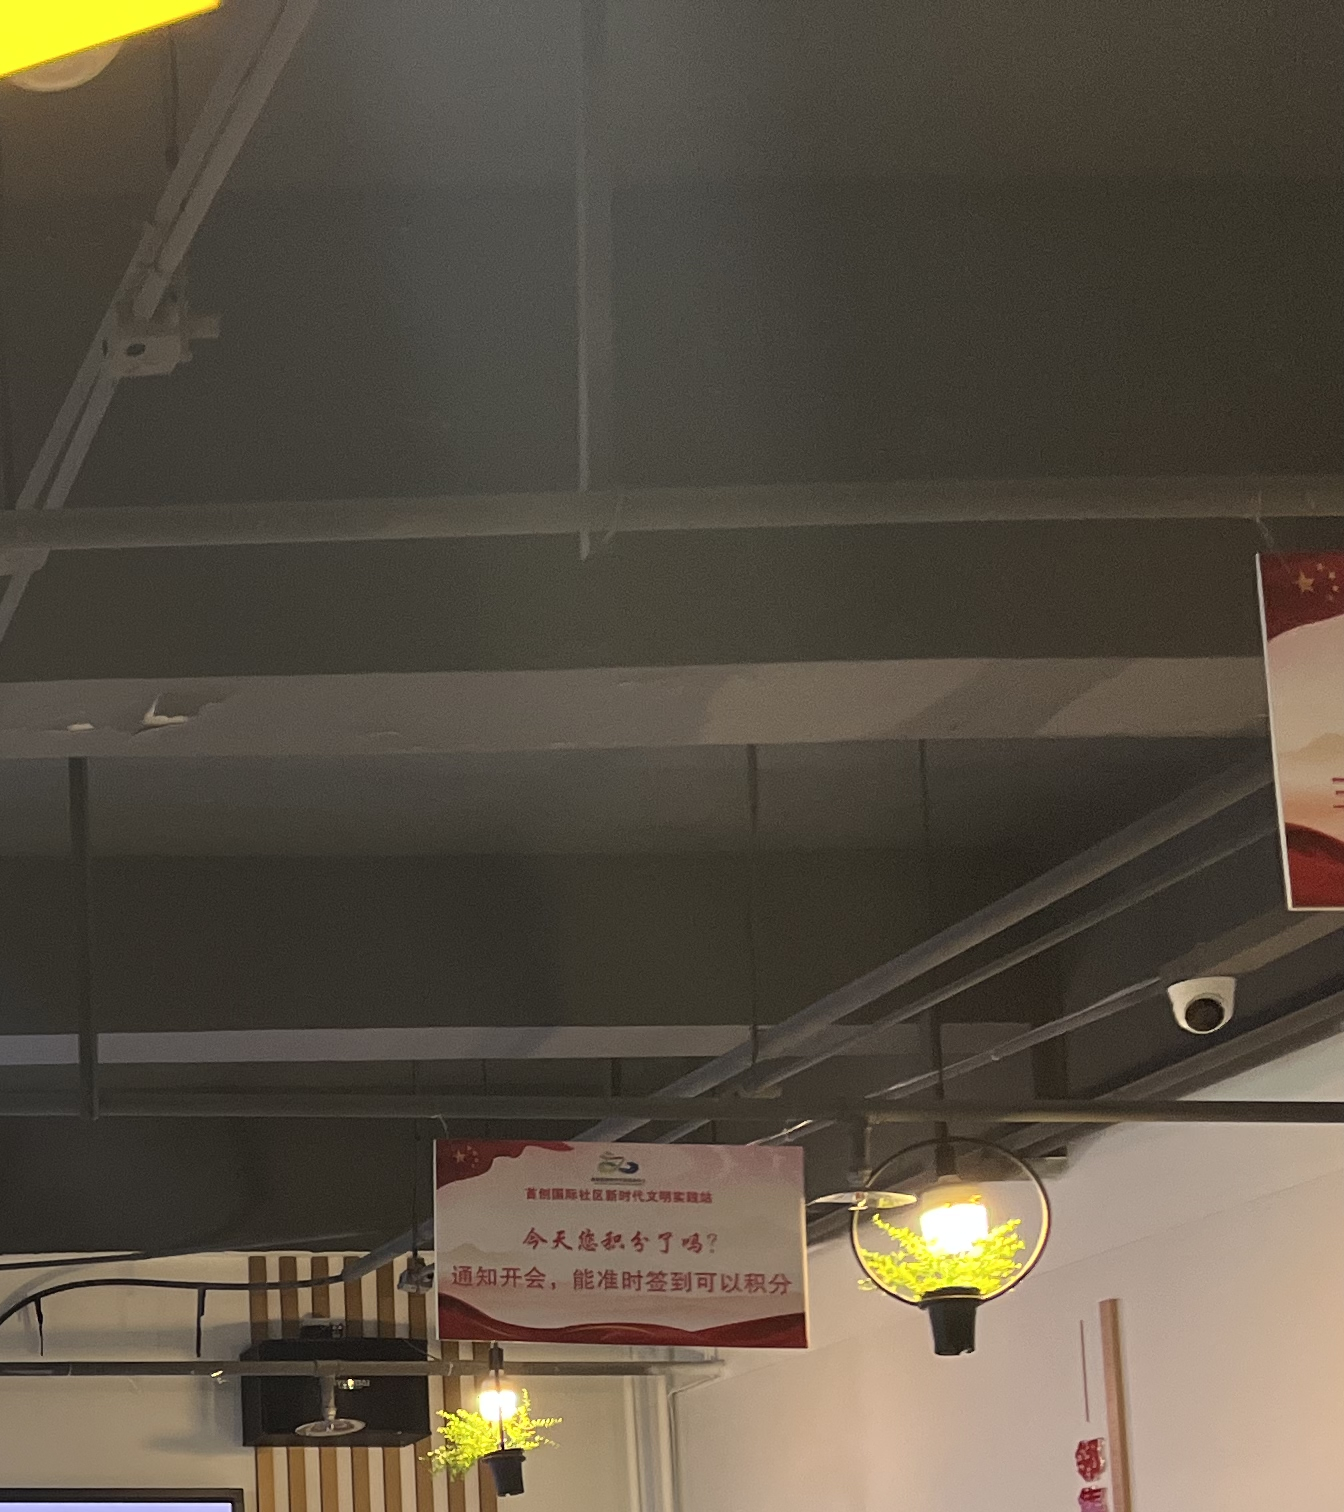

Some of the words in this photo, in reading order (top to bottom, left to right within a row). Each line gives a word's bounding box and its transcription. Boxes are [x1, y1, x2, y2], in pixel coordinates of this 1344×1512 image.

[451, 1264, 793, 1296] 通知开会，能准时签到可以积分
